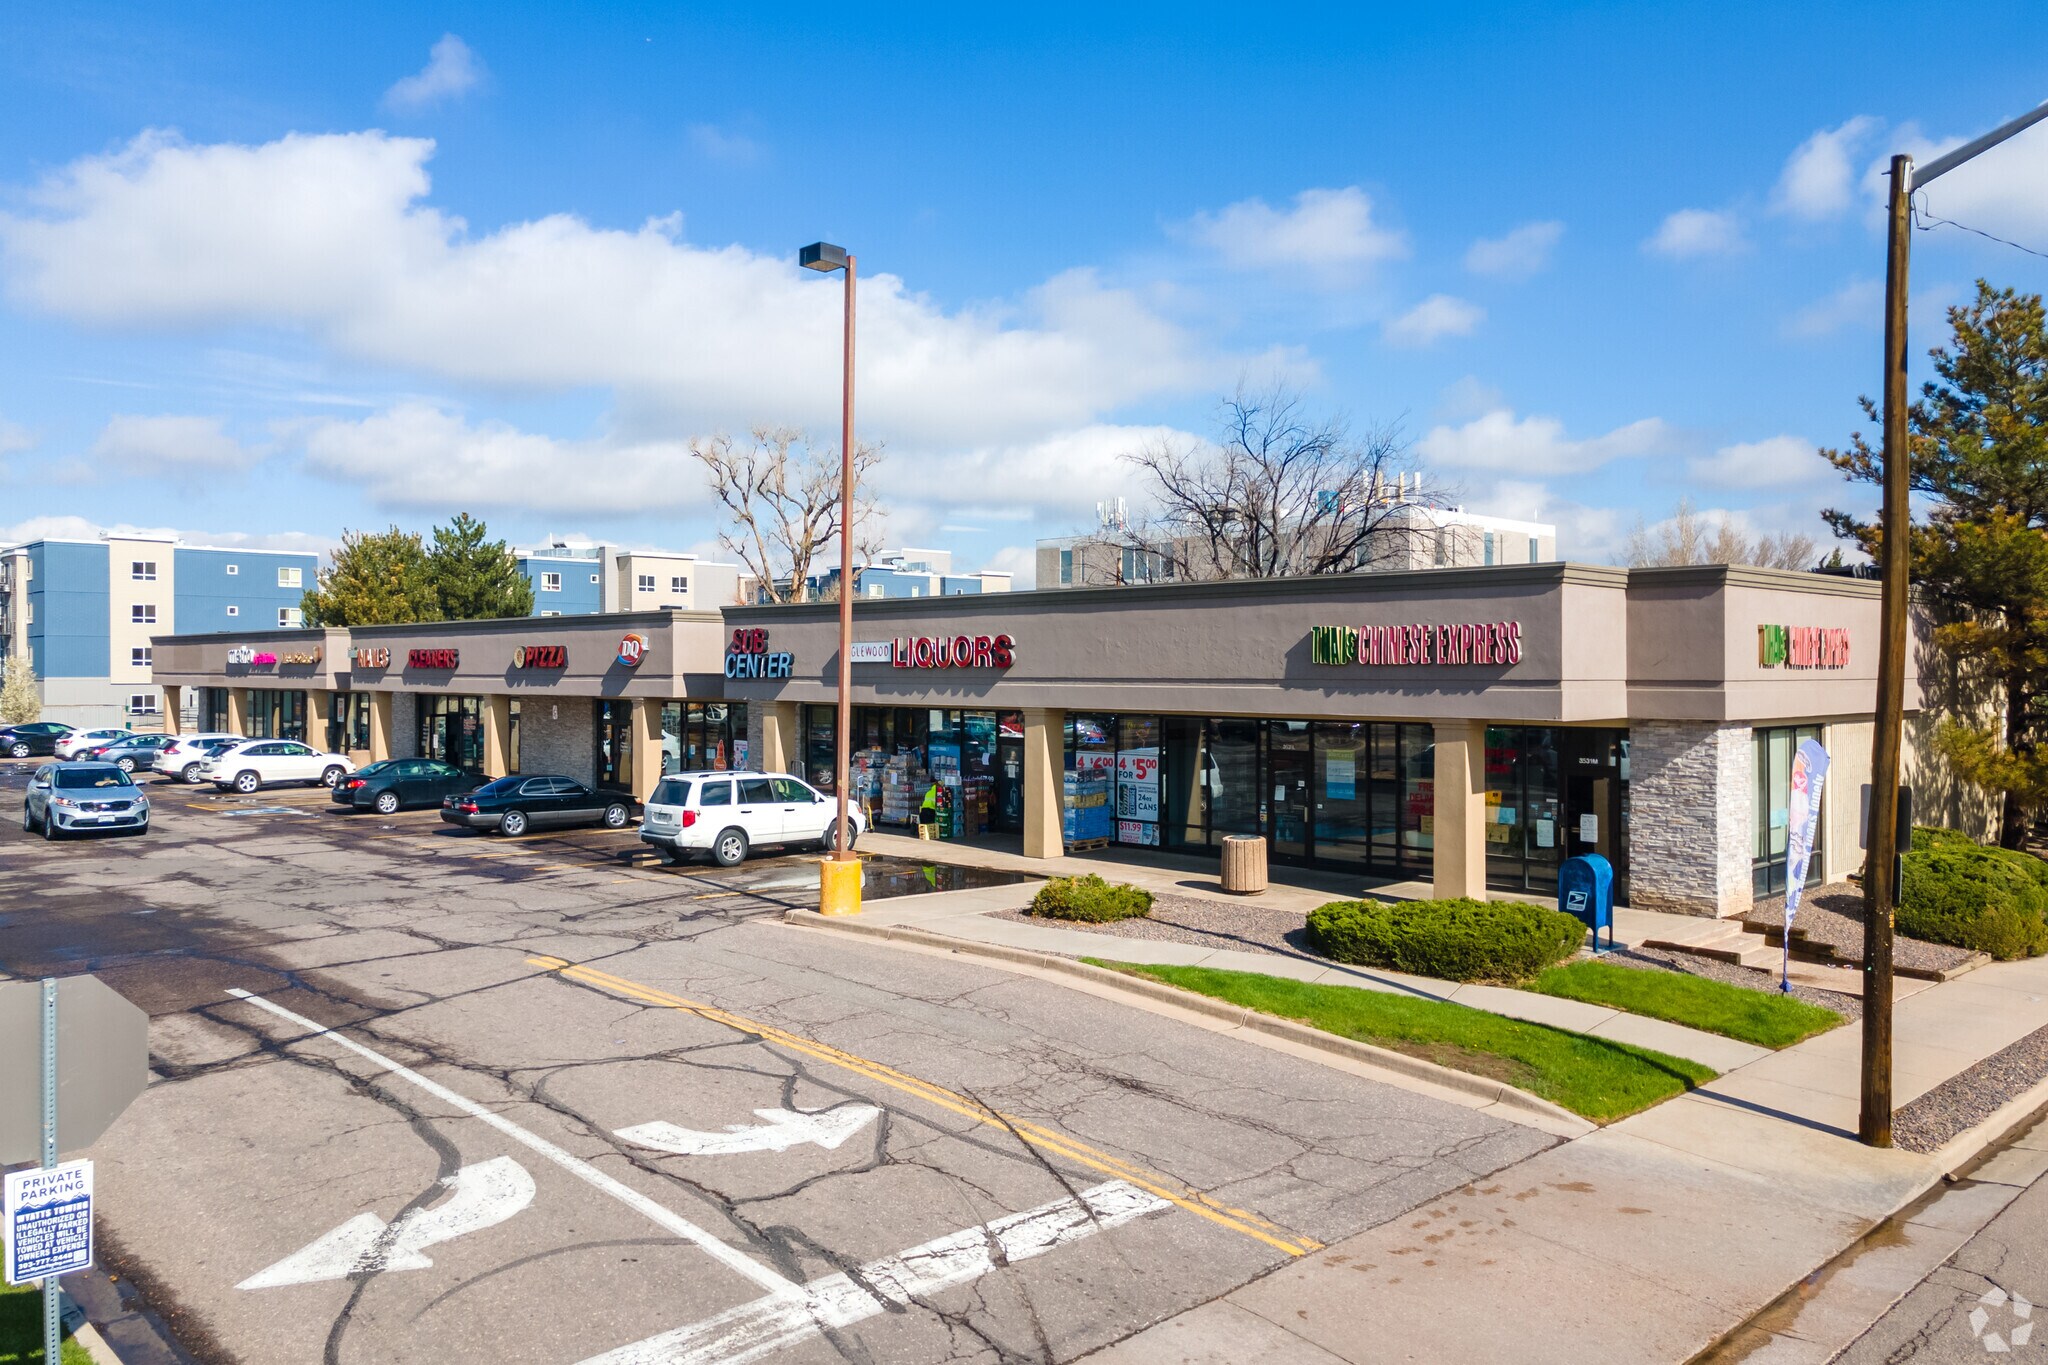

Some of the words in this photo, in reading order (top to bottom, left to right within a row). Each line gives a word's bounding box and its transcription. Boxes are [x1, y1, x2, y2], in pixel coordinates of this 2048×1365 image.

[621, 640, 640, 658] DQ
[731, 628, 768, 654] SUB
[851, 644, 889, 658] GLEWOOD
[893, 634, 1015, 669] LIQUORS
[1311, 626, 1347, 665] THAI
[1358, 624, 1432, 665] CHINESE
[1436, 621, 1523, 664] EXPRESS
[357, 647, 390, 668] NAILS
[408, 648, 458, 669] CLEANERS
[526, 646, 566, 668] PIZZA
[725, 651, 794, 678] CENTER
[1118, 757, 1127, 770] 4
[1118, 770, 1134, 779] FOR
[1138, 803, 1157, 811] CANS
[23, 1169, 82, 1189] PRIVATE
[21, 1180, 84, 1201] PARKING
[16, 1213, 75, 1232] UNAUTHORIZED
[76, 1210, 88, 1219] OR
[16, 1225, 56, 1239] ILLEGALLY
[58, 1218, 88, 1231] PARKED
[16, 1243, 43, 1255] TOWED
[45, 1240, 54, 1249] AT
[56, 1232, 88, 1246] VEHICLE
[18, 1232, 54, 1247] VEHICLES
[56, 1228, 75, 1238] WILL
[76, 1225, 87, 1233] BE
[18, 1248, 51, 1262] OWNERS
[52, 1240, 87, 1255] EXPENSE
